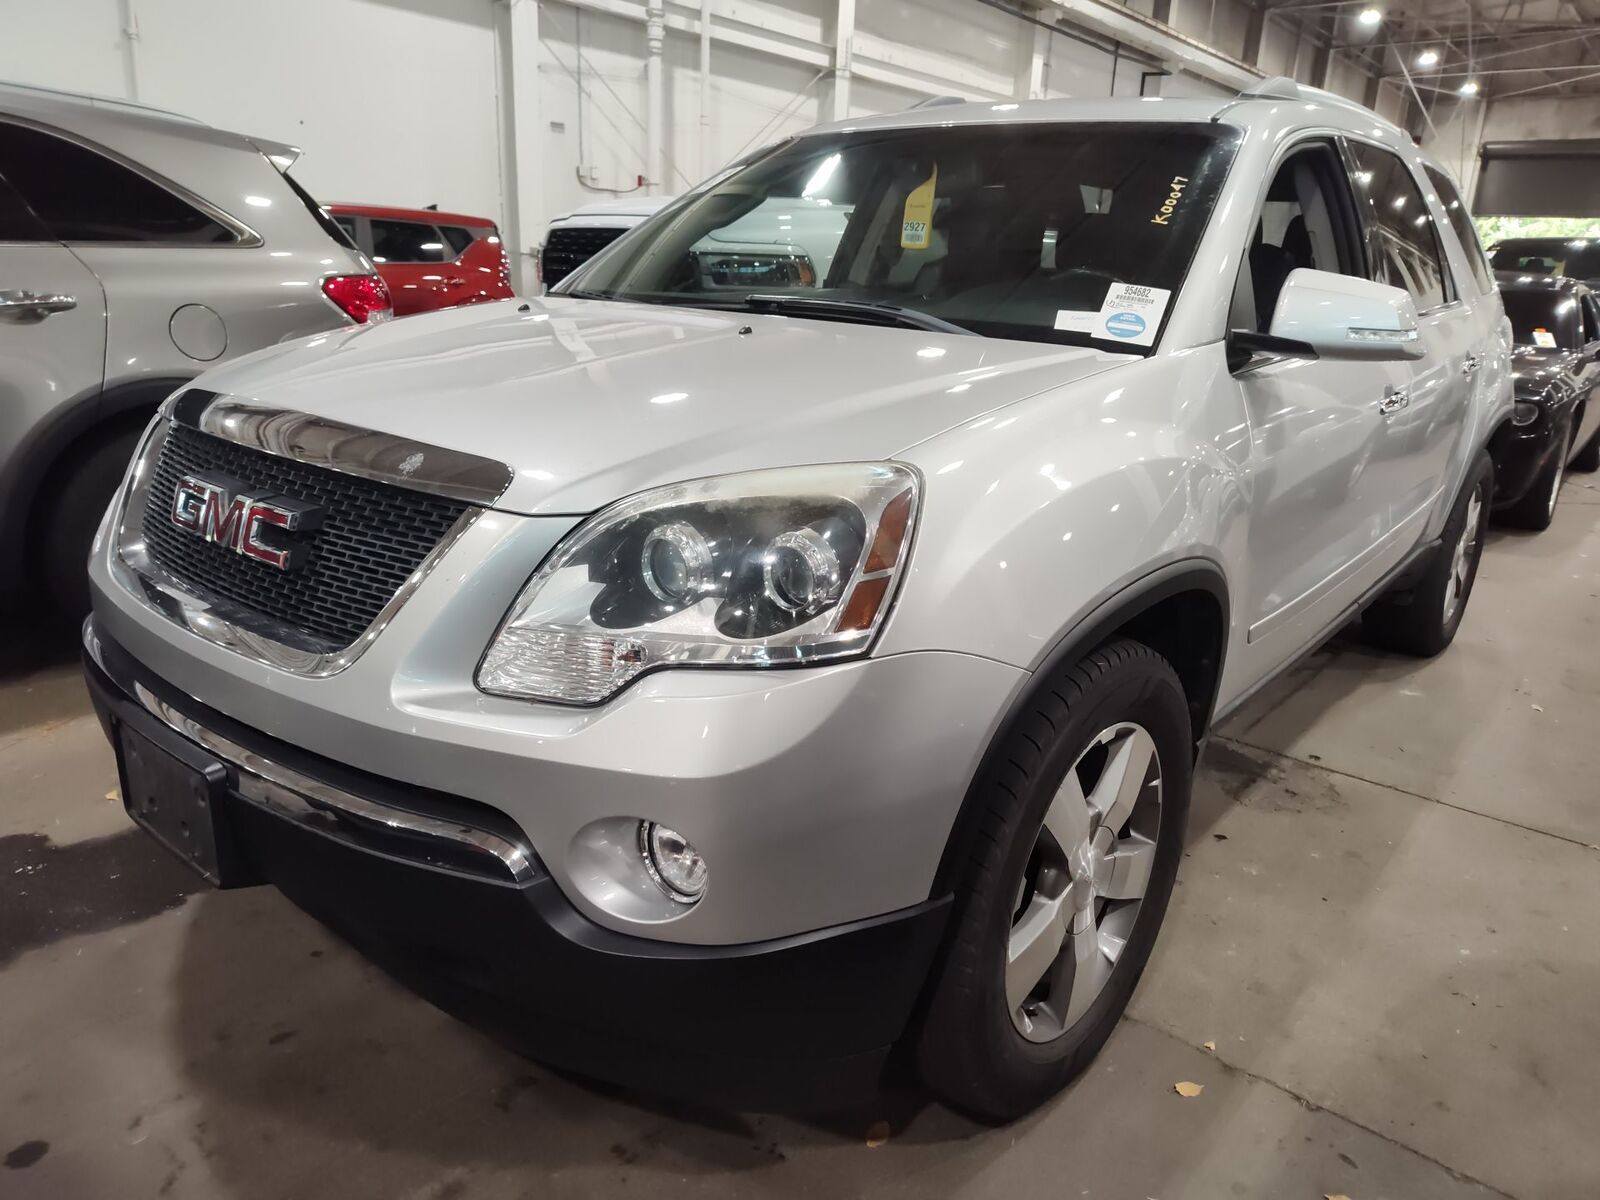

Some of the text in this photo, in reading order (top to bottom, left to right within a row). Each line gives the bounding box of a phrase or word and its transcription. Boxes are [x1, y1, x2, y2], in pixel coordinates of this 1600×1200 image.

[903, 222, 927, 232] 2927
[1123, 285, 1152, 298] 954682
[171, 475, 299, 571] GMC
